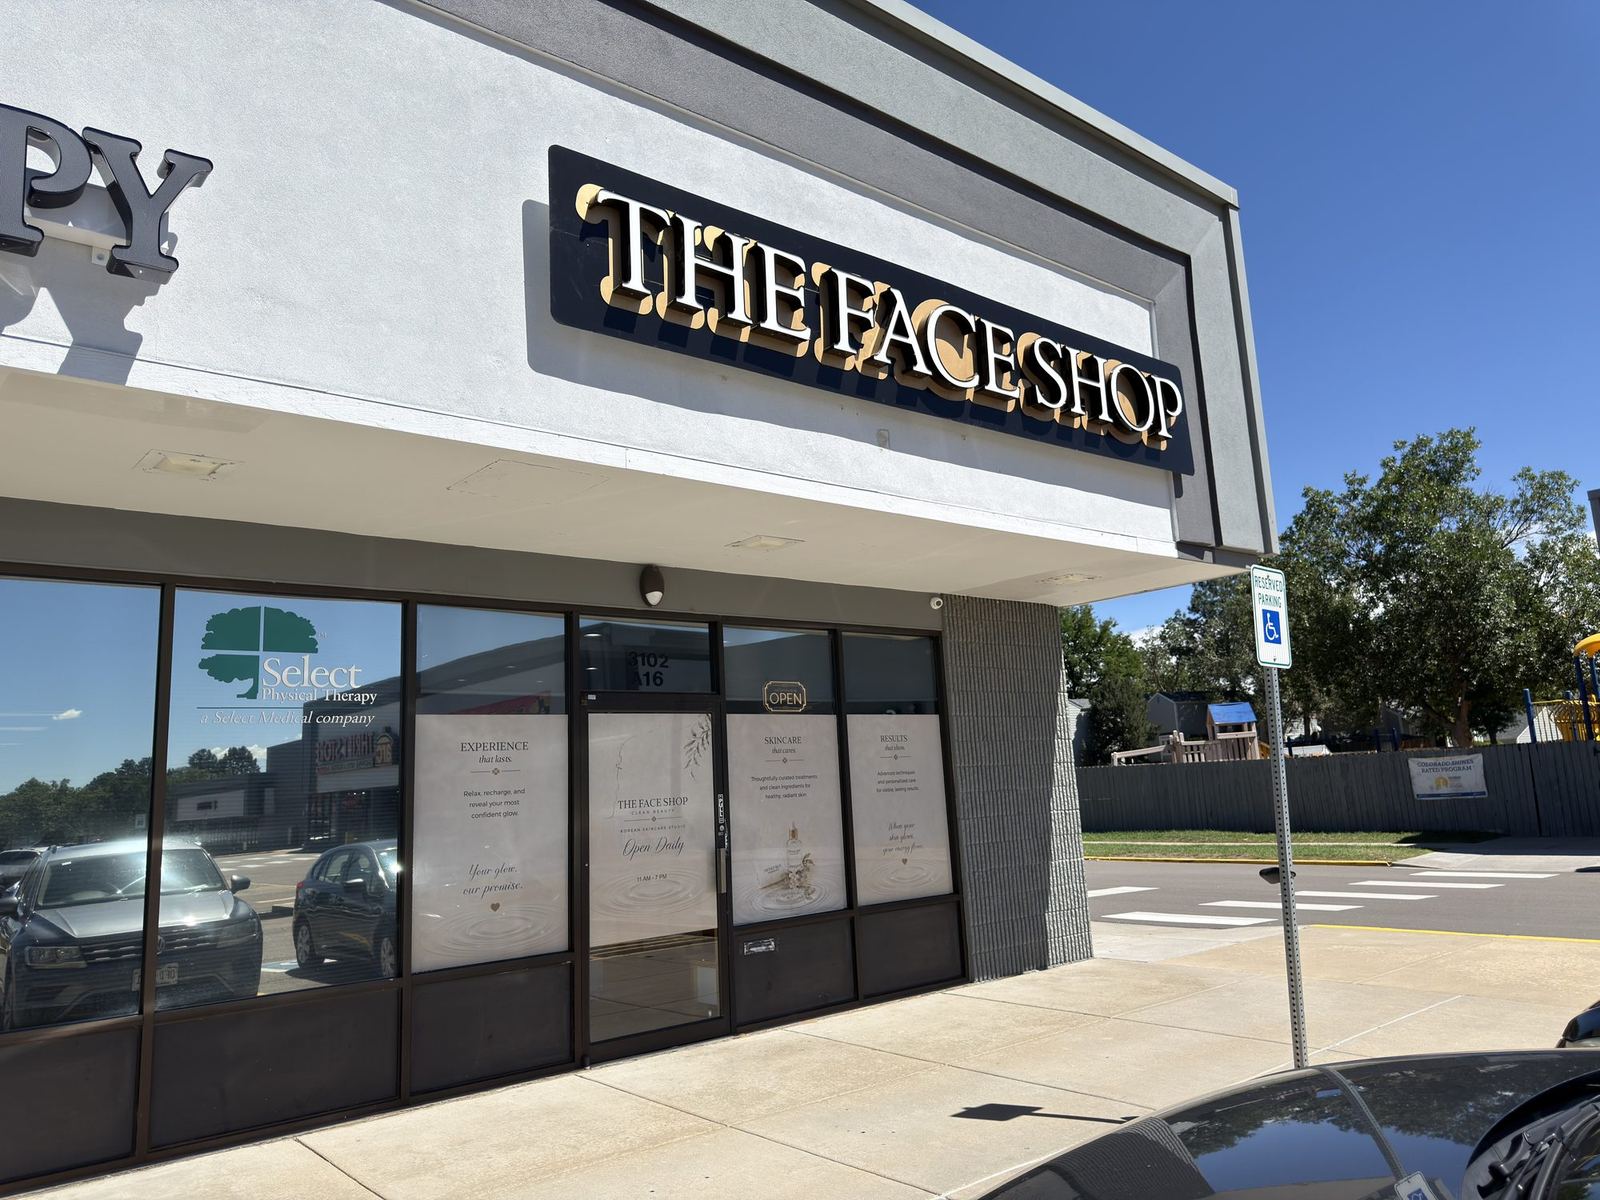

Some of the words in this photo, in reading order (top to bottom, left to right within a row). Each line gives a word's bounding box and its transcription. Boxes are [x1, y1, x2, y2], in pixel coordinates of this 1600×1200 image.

[596, 188, 812, 342] THE
[821, 267, 1022, 402] FACE
[1030, 337, 1183, 440] SHOP
[1254, 575, 1283, 593] RESERVED
[1258, 593, 1282, 608] PARKING
[629, 651, 669, 668] 3102
[262, 654, 362, 689] Select
[262, 688, 317, 704] Physical
[323, 689, 378, 705] Therapy
[769, 692, 802, 705] OPEN
[200, 714, 208, 724] a
[213, 710, 254, 724] Select
[258, 710, 312, 724] Medical
[315, 714, 376, 728] company
[764, 736, 802, 745] SKINCARE
[880, 734, 909, 743] RESULTS
[460, 741, 529, 752] EXPERIENCE
[478, 754, 494, 763] that
[483, 789, 512, 798] recharge,
[469, 800, 488, 808] reveal
[488, 800, 503, 809] your
[617, 799, 637, 809] THE
[638, 798, 662, 808] FACE
[663, 796, 689, 807] SHOP
[471, 810, 502, 819] confident
[622, 838, 651, 861] Open
[655, 836, 685, 856] Daily
[468, 863, 493, 881] Your
[462, 886, 481, 895] our
[480, 881, 523, 900] promise.
